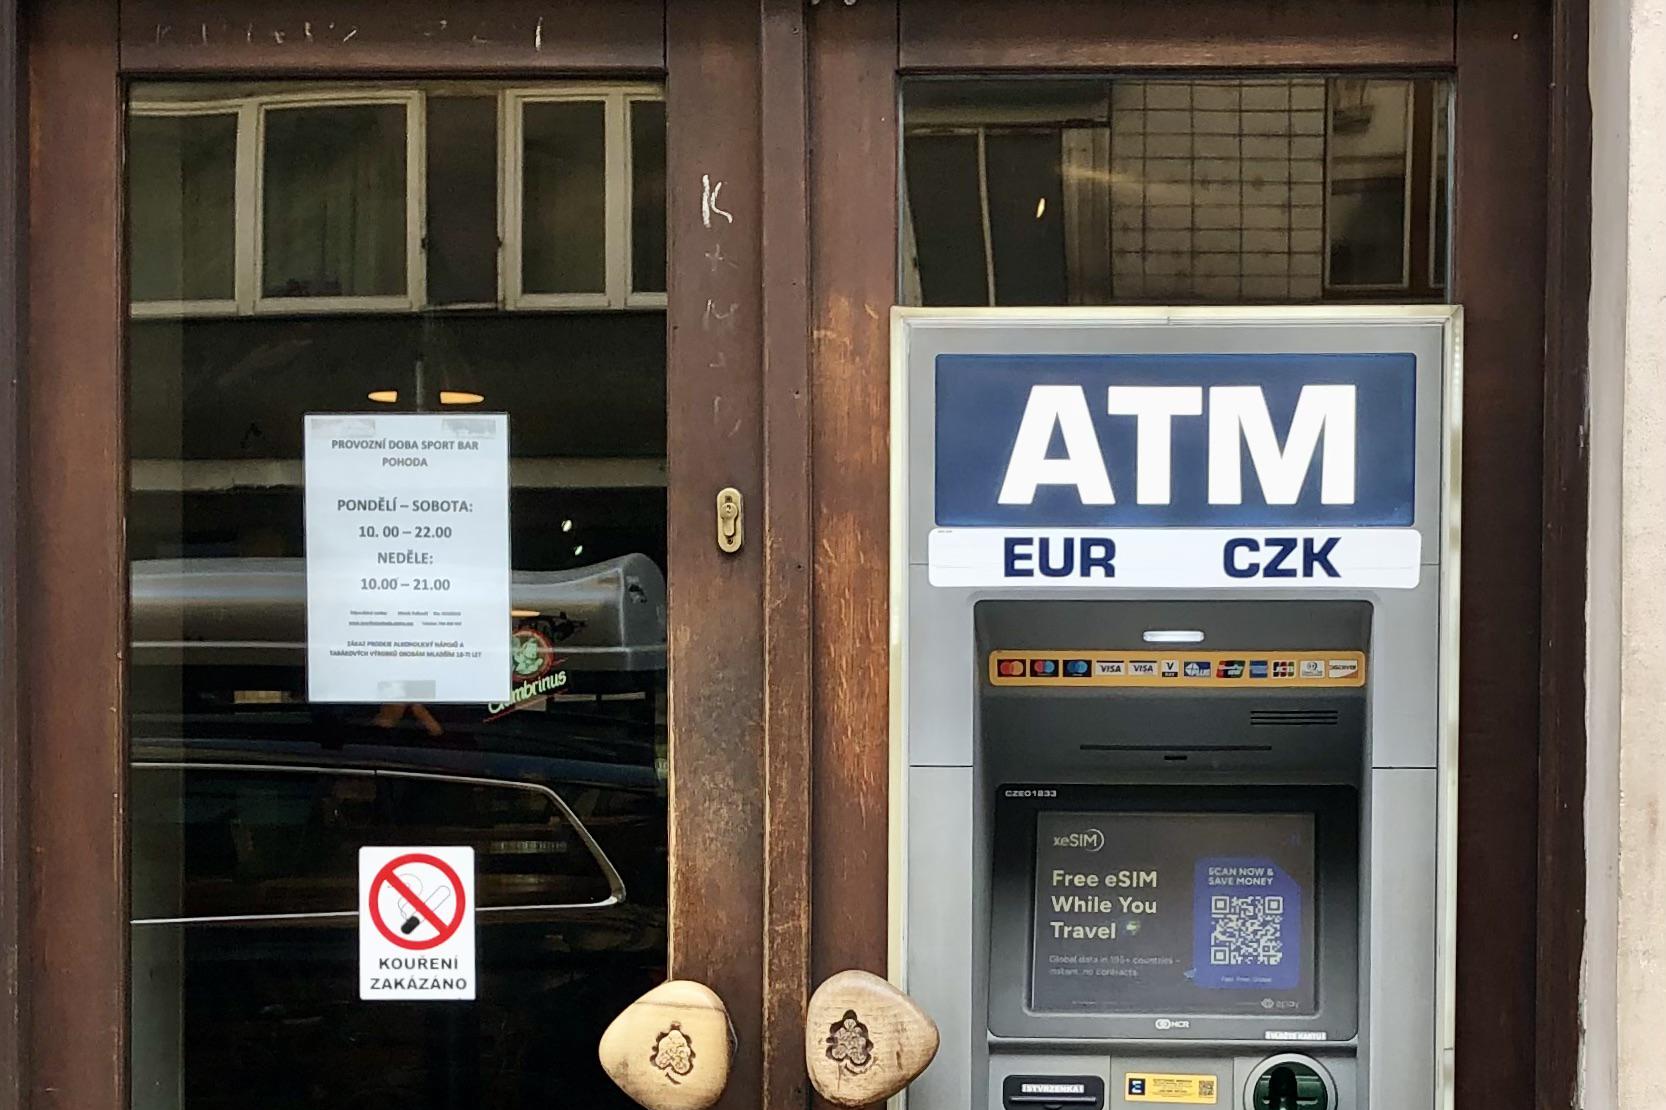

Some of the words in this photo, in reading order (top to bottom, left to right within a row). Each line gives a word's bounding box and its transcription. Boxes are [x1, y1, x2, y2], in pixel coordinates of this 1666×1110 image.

[331, 438, 386, 450] PROVOZNÍ
[388, 440, 419, 450] DOBA
[421, 440, 455, 450] SPORT
[457, 441, 479, 450] BAR
[997, 384, 1356, 505] ATM
[382, 457, 428, 467] POHODA
[337, 497, 398, 512] PONDĚLÍ
[412, 500, 473, 512] SOBOTA:
[414, 526, 452, 538] 22.00
[377, 549, 434, 565] NEDĚLE:
[1003, 536, 1117, 578] EUR
[1222, 536, 1342, 578] CZK
[360, 578, 398, 591] 10.00
[413, 579, 450, 591] 21.00
[1100, 664, 1122, 673] VISA
[1133, 664, 1154, 672] VISA
[1053, 833, 1098, 847] xeSIM
[1052, 869, 1099, 887] Free
[1104, 870, 1157, 888] eSIM
[1208, 867, 1236, 876] SCAN
[1239, 867, 1264, 876] NOW
[1266, 868, 1274, 876] &
[1208, 876, 1234, 885] SAVE
[1236, 877, 1274, 886] MONEY
[1051, 895, 1112, 913] While
[1118, 896, 1157, 914] You
[1050, 921, 1116, 939] Travel
[379, 955, 459, 970] KOUŘENÍ
[370, 975, 468, 990] ZAKÁZÁNO
